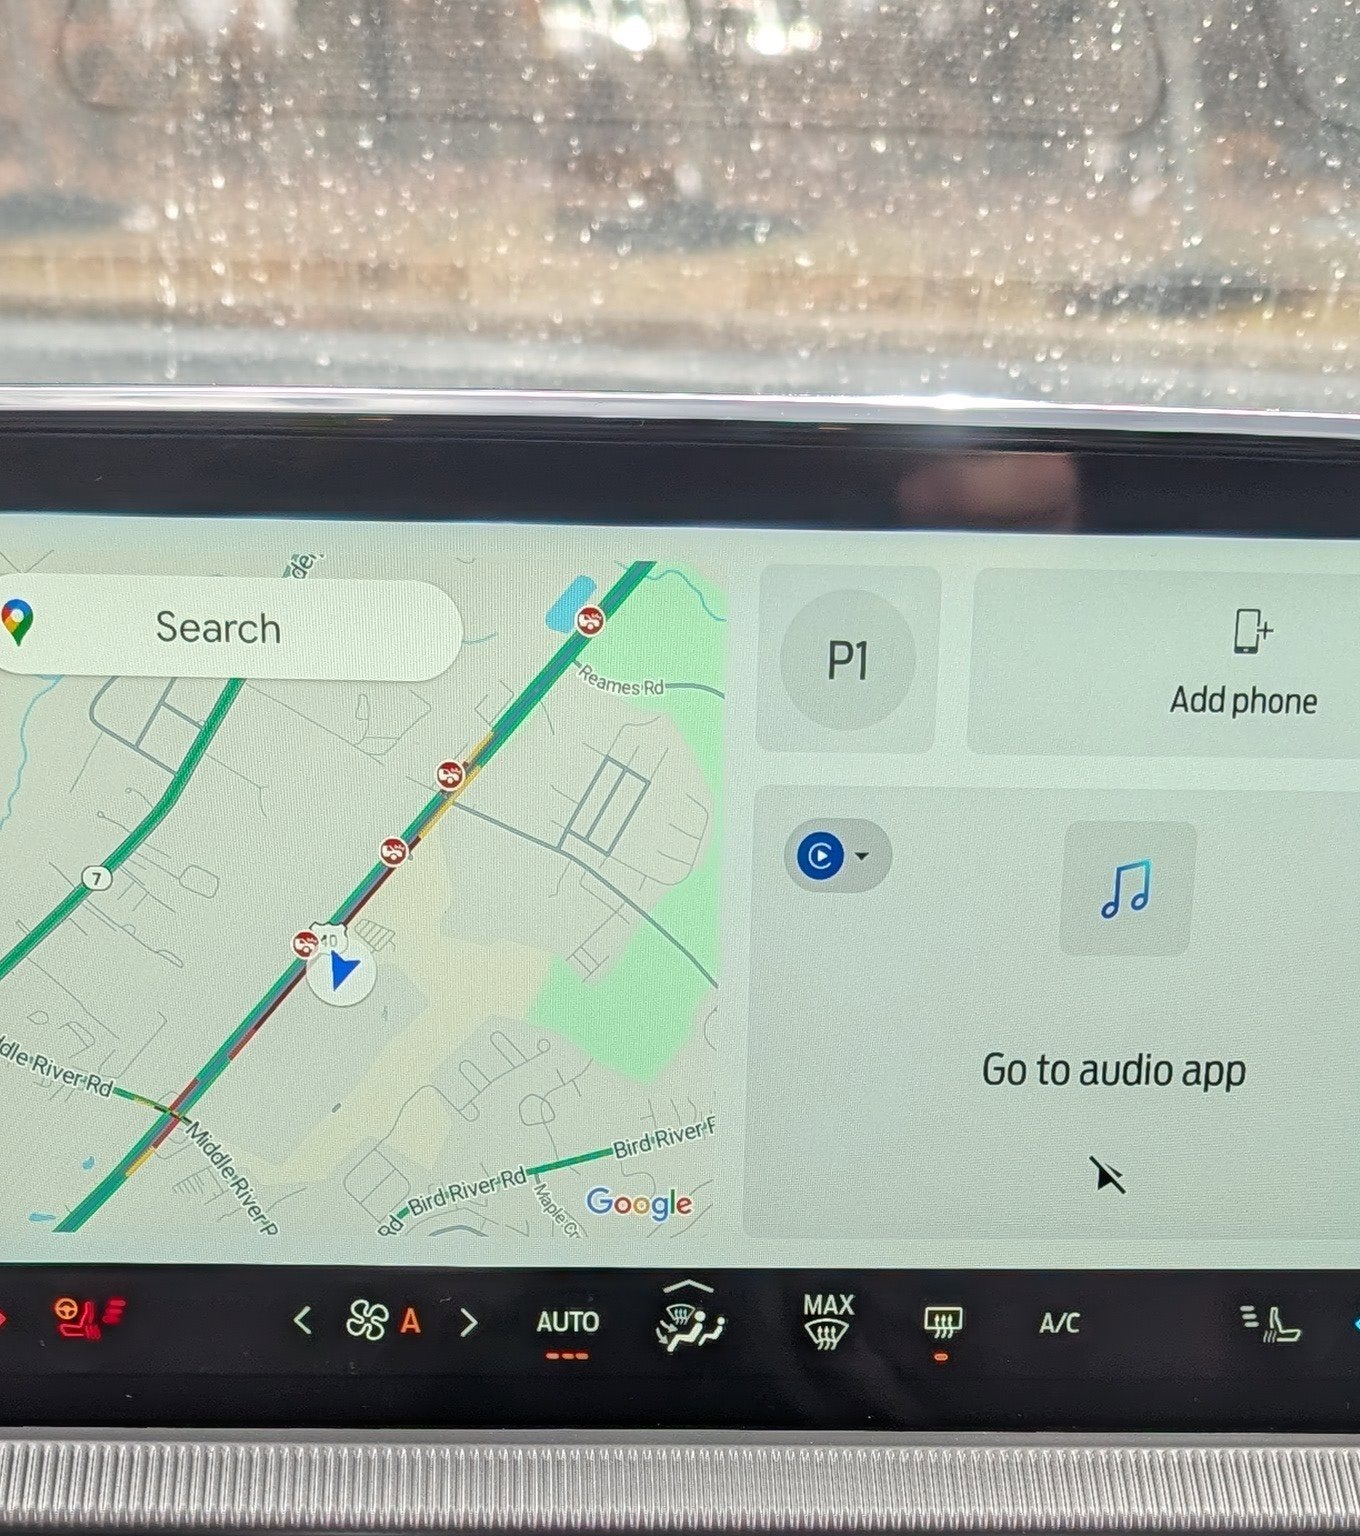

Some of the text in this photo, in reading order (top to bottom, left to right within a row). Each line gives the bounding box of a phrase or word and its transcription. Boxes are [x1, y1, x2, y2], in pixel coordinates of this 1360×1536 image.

[155, 610, 282, 645] Search
[826, 638, 869, 682] P1
[578, 664, 664, 696] Reames Rd
[1169, 684, 1319, 718] Add phone
[91, 872, 102, 887] 7
[32, 1054, 84, 1087] River
[86, 1074, 115, 1098] Rd
[981, 1051, 1248, 1095] Go to audio app
[613, 1133, 652, 1160] Bird
[654, 1121, 703, 1149] River
[184, 1120, 236, 1180] Middle
[229, 1177, 268, 1222] River
[408, 1165, 528, 1217] Bird River Rd
[533, 1183, 566, 1226] Maple
[586, 1186, 693, 1223] Google
[400, 1307, 421, 1335] A
[535, 1309, 601, 1334] AUTO
[803, 1294, 855, 1317] MAX
[1038, 1312, 1081, 1336] A/C
